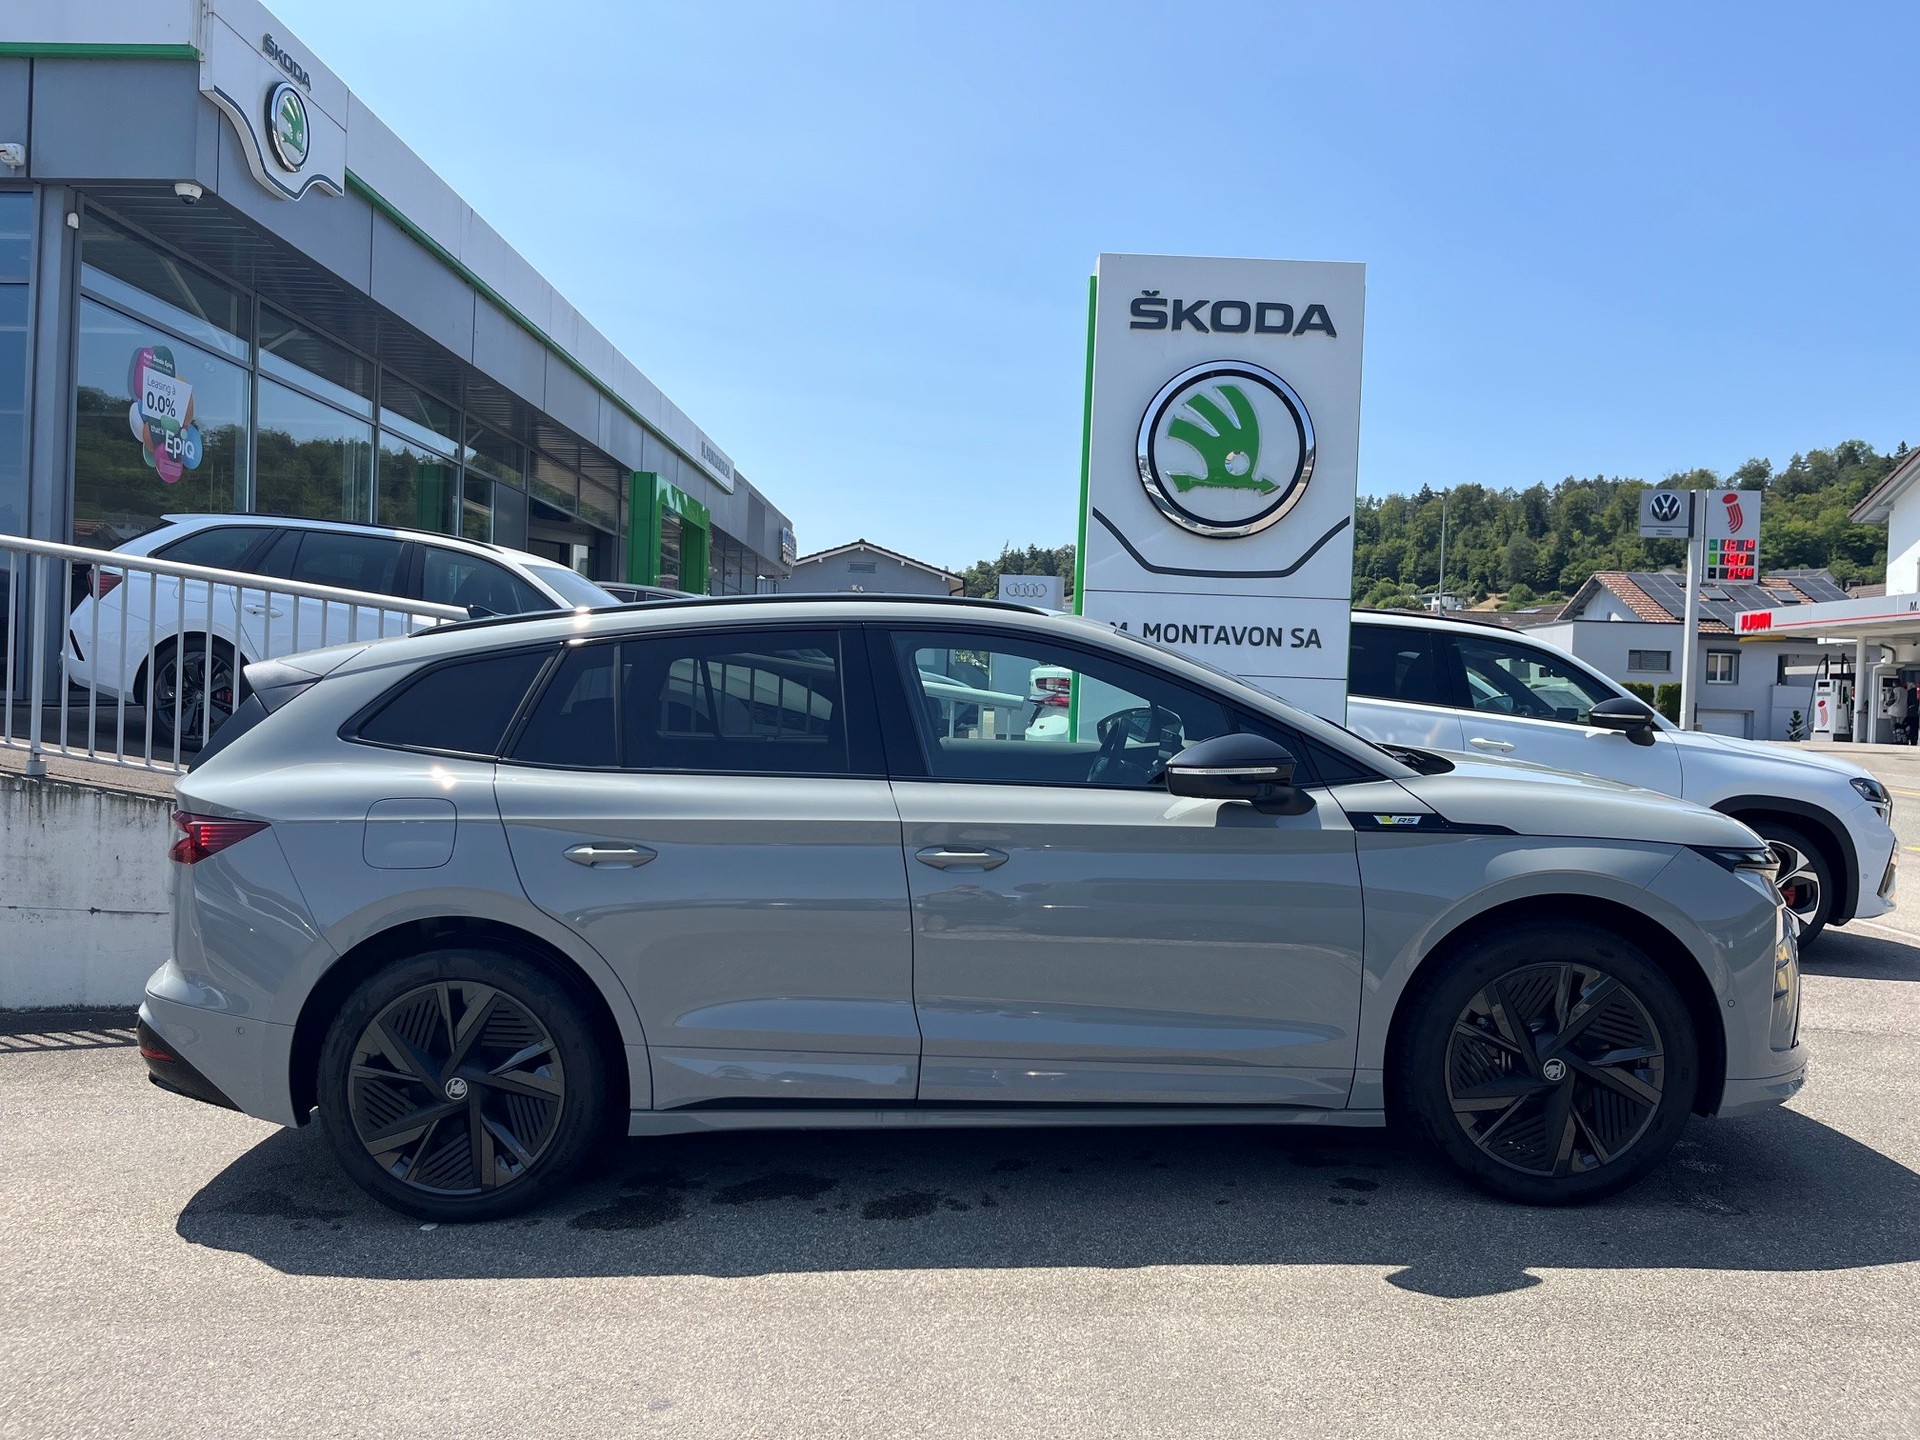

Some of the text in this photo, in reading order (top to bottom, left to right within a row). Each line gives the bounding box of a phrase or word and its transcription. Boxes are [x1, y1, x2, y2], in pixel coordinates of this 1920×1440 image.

[262, 33, 311, 92] ŠKODA
[1130, 290, 1337, 338] ŠKODA
[147, 375, 171, 396] Leasing
[146, 391, 176, 418] 0.0%
[1143, 622, 1283, 648] MONTAVON
[1290, 627, 1323, 649] SA
